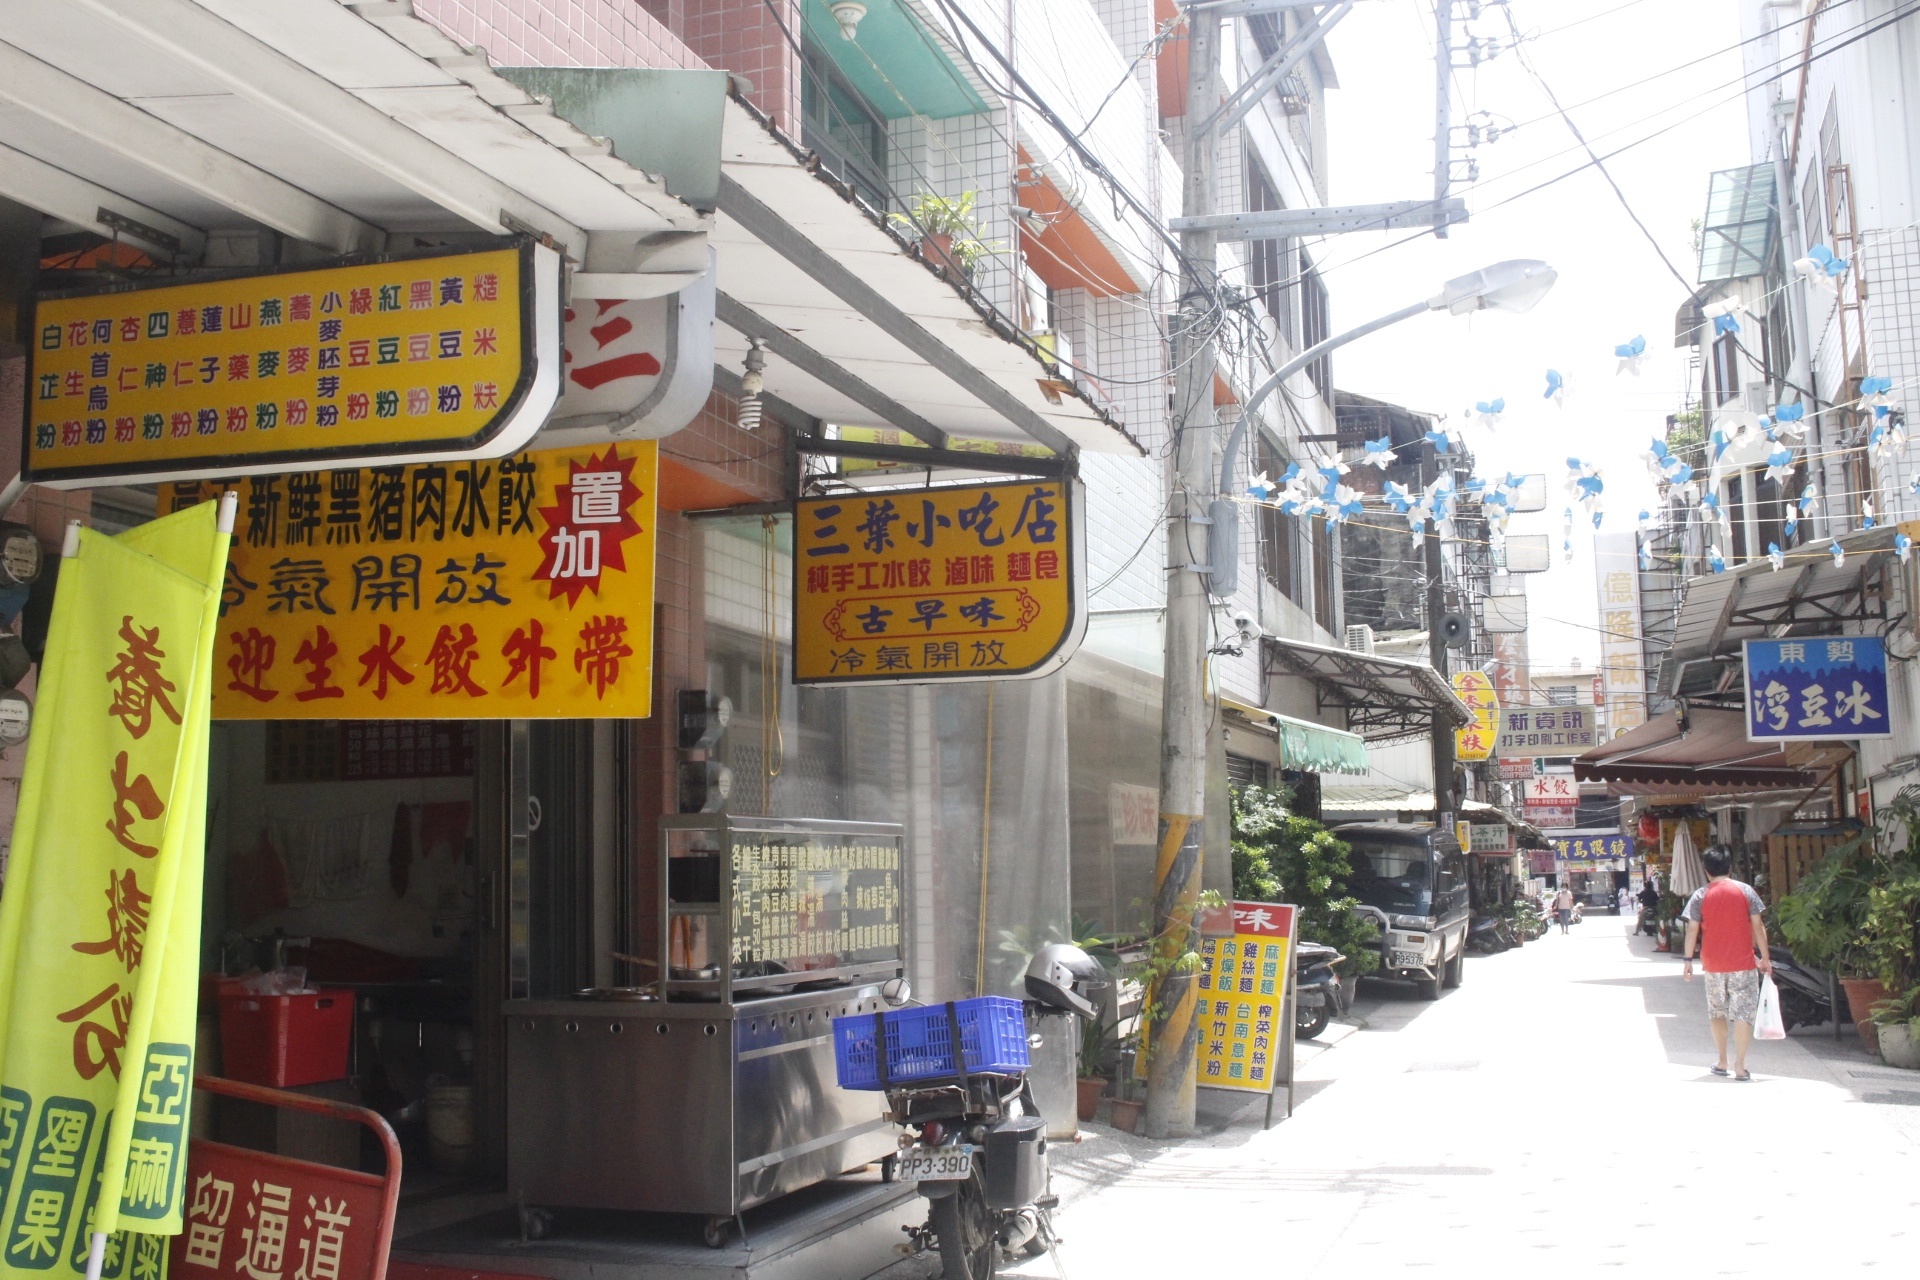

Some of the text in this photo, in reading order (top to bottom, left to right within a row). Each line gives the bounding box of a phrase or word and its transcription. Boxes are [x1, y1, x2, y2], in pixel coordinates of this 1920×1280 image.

[35, 324, 62, 450] 白芷粉
[61, 321, 89, 446] 花生粉
[85, 317, 113, 444] 何首烏粉
[115, 315, 142, 443] 杏仁粉
[141, 311, 170, 440] 四神粉
[170, 307, 198, 438] 薏仁粉
[197, 304, 224, 435] 蓮子粉
[226, 301, 252, 432] 山藥粉
[255, 297, 283, 429] 燕麥粉
[286, 294, 312, 426] 蕎麥粉
[316, 290, 343, 427] 小麥胚芽粉
[347, 287, 374, 420] 綠豆粉
[376, 283, 403, 417] 紅豆粉
[407, 280, 433, 415] 黑豆粉
[437, 277, 464, 413] 黃豆粉
[806, 487, 1058, 558] 三葉小吃店
[806, 550, 1059, 594] 純手工水餃 滷味 麵食
[209, 615, 634, 703] 迎生水餃外帶
[830, 640, 1009, 674] 冷氣開放
[855, 597, 1005, 634] 古早味
[1779, 641, 1854, 663] 東勢
[1502, 732, 1591, 747] 打字印刷工作室
[1508, 711, 1583, 731] 新資訊
[1533, 779, 1570, 795] 水餃
[1557, 838, 1627, 859] 寶島眼鏡
[732, 844, 741, 965] 各式小菜
[1218, 941, 1237, 992] 肉燥飯
[1239, 942, 1258, 994] 雞絲麵
[1260, 945, 1280, 996] 麻醬麵
[1206, 1000, 1229, 1076] 新竹米粉
[1228, 1002, 1251, 1079] 台南意麵
[1249, 1004, 1272, 1081] 榨菜肉絲麵
